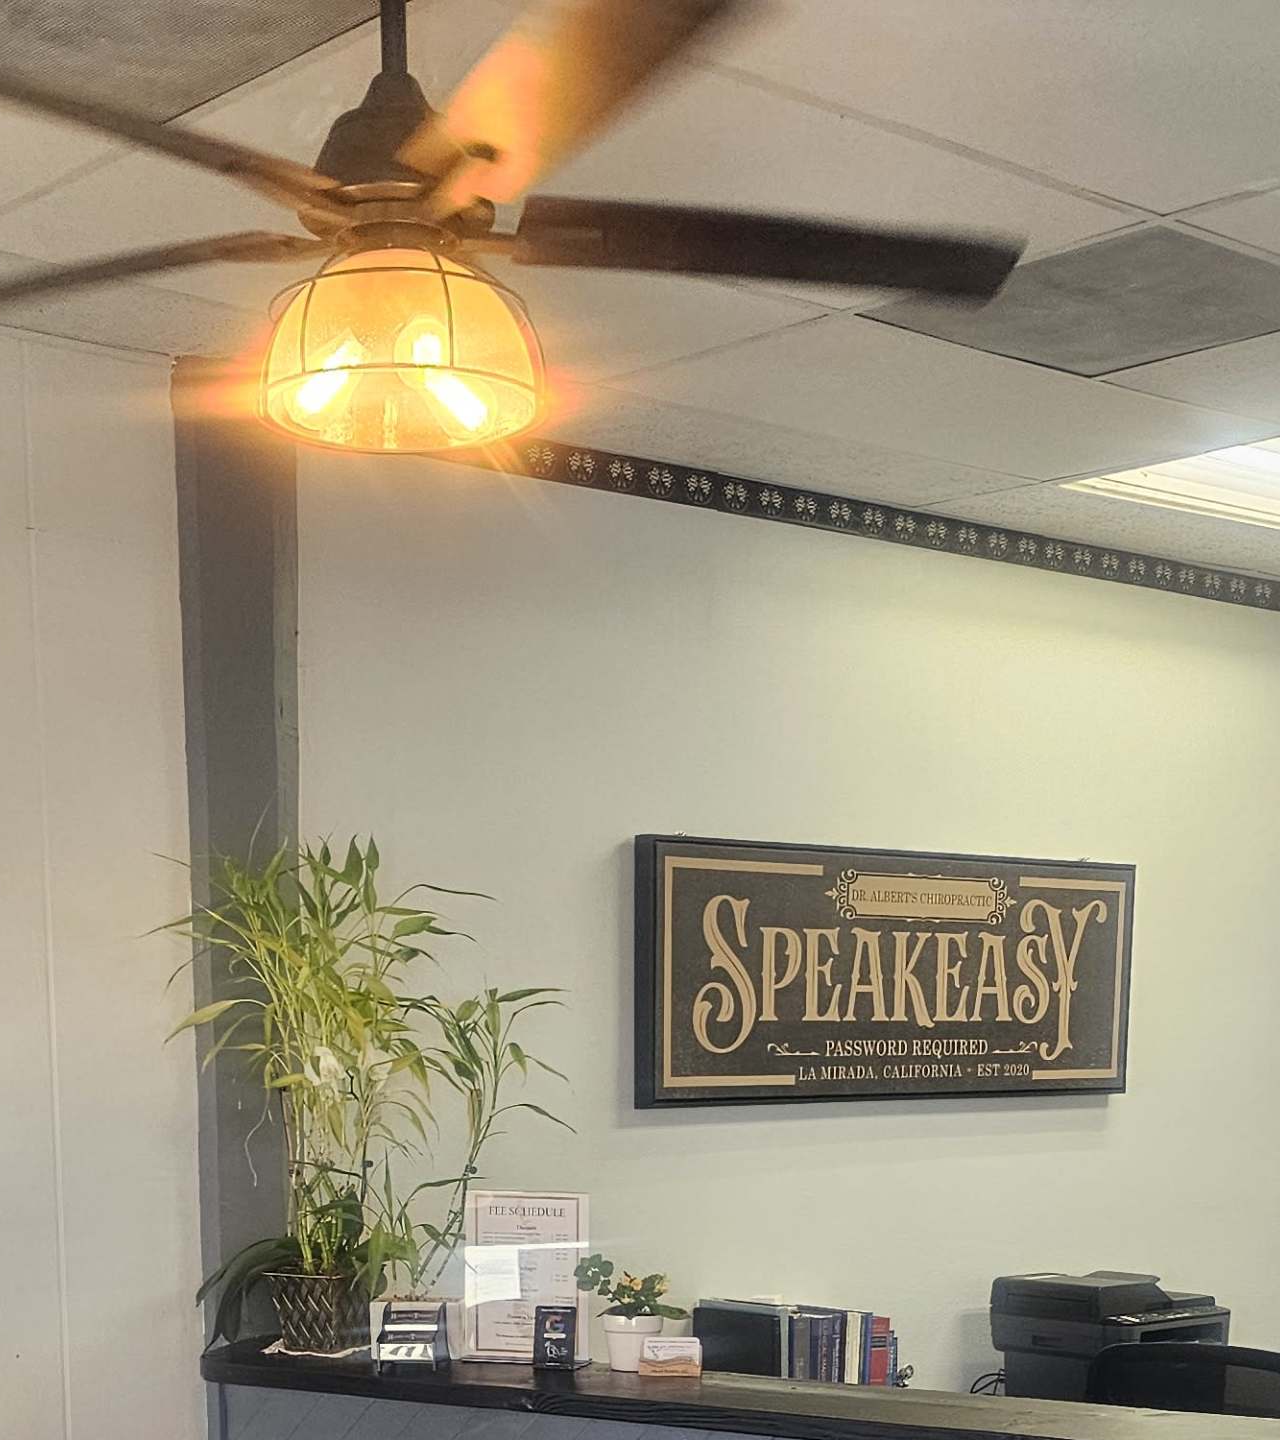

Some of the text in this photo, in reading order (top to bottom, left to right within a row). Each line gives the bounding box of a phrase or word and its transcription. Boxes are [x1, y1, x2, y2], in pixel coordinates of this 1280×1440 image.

[871, 891, 918, 904] ALBERT'S
[919, 893, 993, 908] CHIROPRACTIC
[693, 893, 1107, 1061] SPEAKEASY
[825, 1039, 988, 1059] PASSWORD REQUIRED
[799, 1066, 817, 1081] LA
[883, 1064, 962, 1078] CALIFORNIA
[977, 1063, 999, 1077] EST
[1003, 1064, 1030, 1077] 2020
[489, 1205, 566, 1217] FEE SCHEDULE
